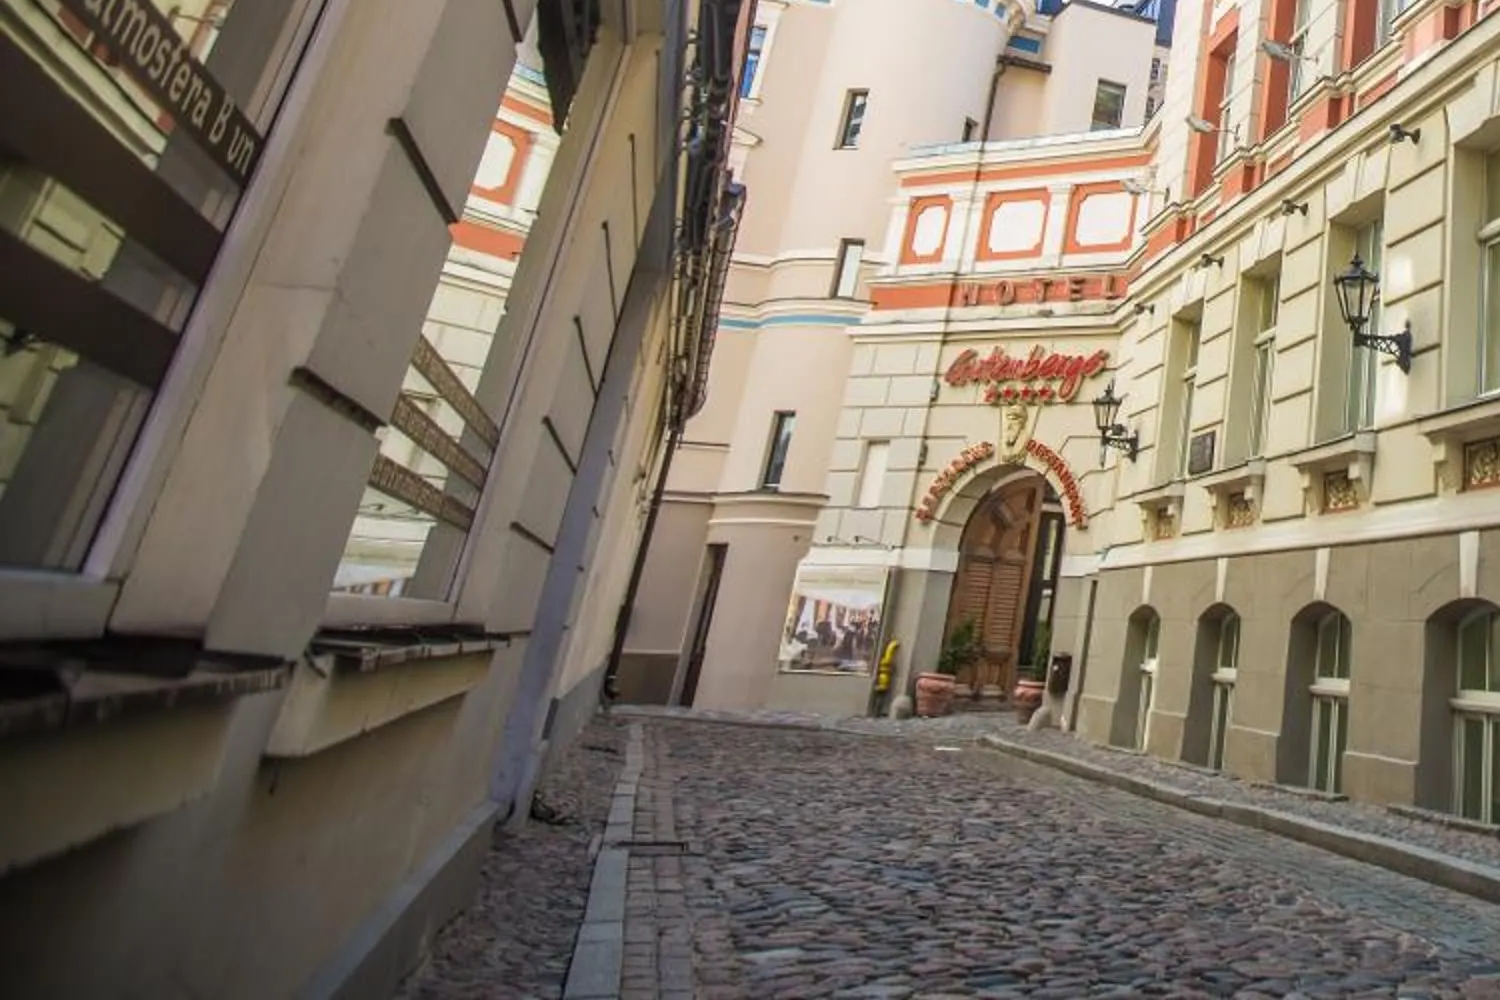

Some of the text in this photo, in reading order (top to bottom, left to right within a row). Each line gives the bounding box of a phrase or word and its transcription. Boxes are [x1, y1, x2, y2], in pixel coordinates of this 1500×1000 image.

[227, 124, 255, 178] un
[957, 273, 1121, 307] HOTEL
[944, 344, 1110, 403] Gutenbergs
